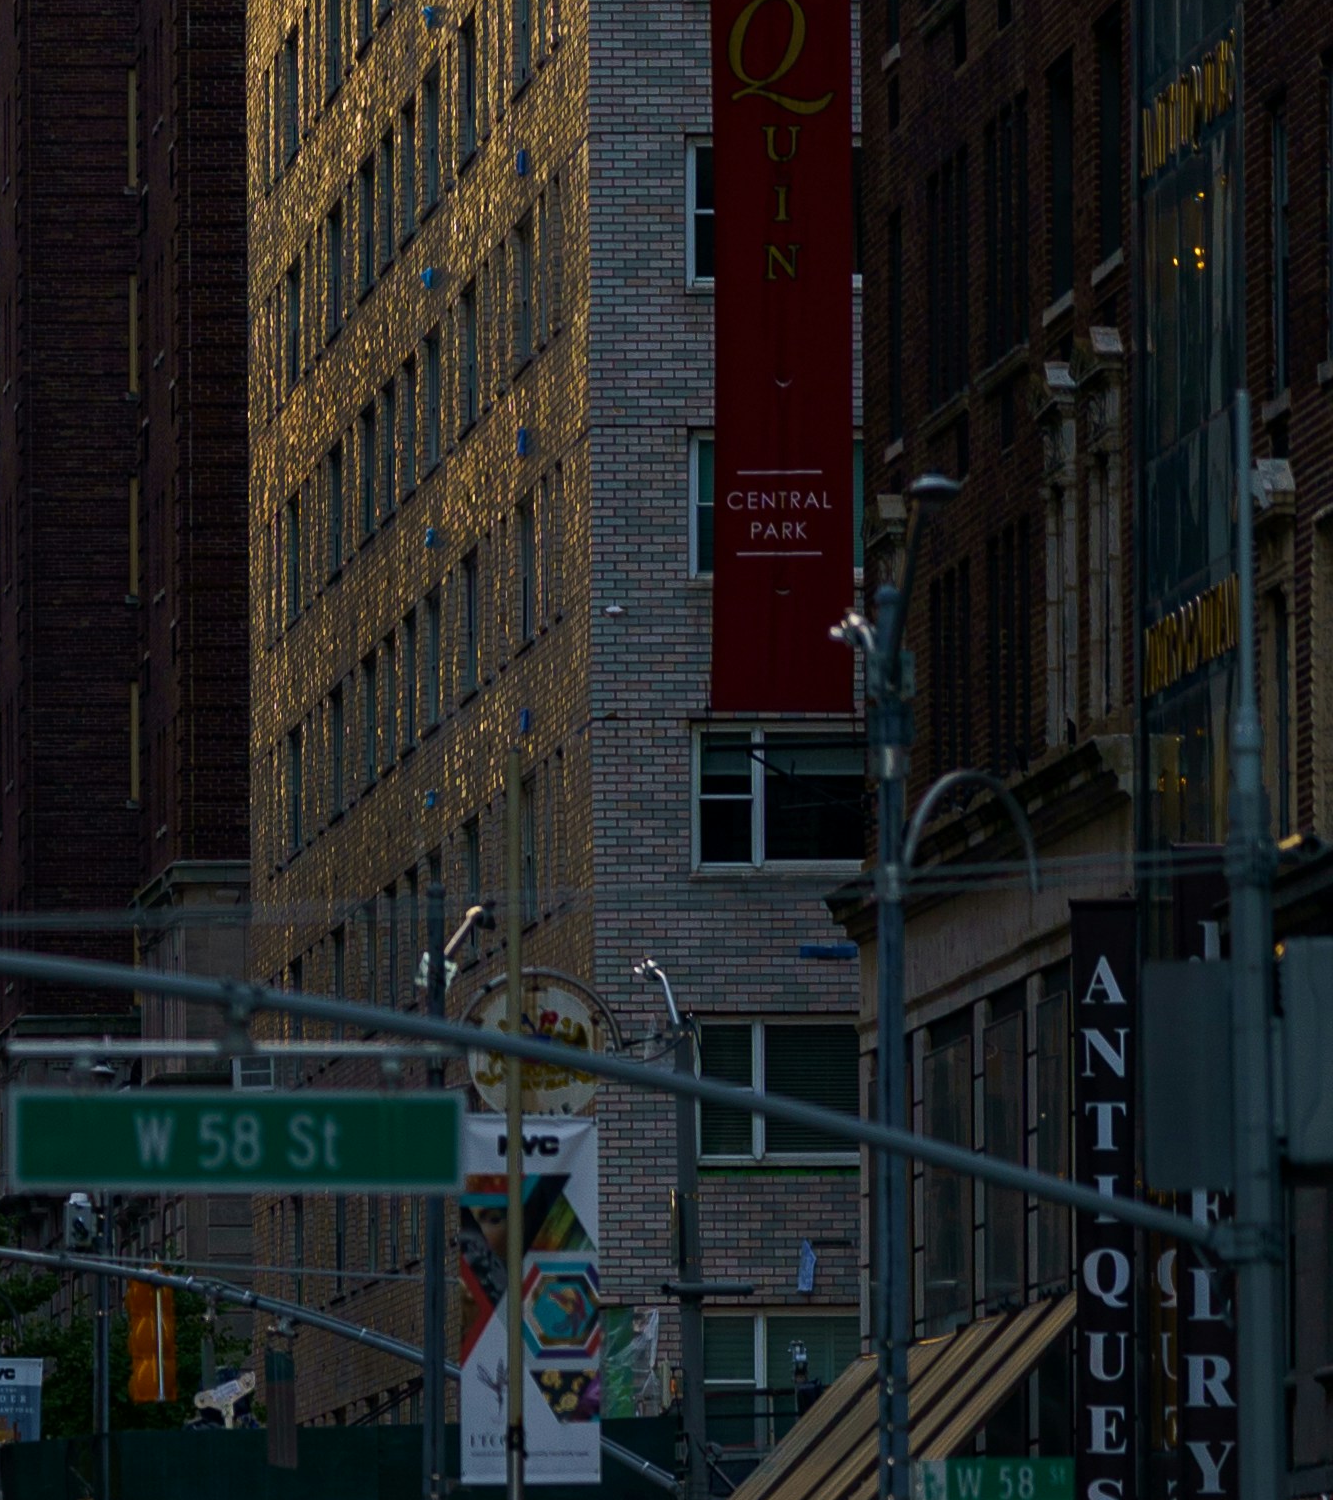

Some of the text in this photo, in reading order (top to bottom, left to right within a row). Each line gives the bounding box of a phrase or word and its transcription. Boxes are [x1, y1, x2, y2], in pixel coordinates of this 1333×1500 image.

[726, 490, 834, 511] CENTRAL
[750, 521, 808, 540] PARK
[136, 1113, 339, 1169] W 58 St
[955, 1466, 983, 1500] W
[999, 1465, 1035, 1500] 58
